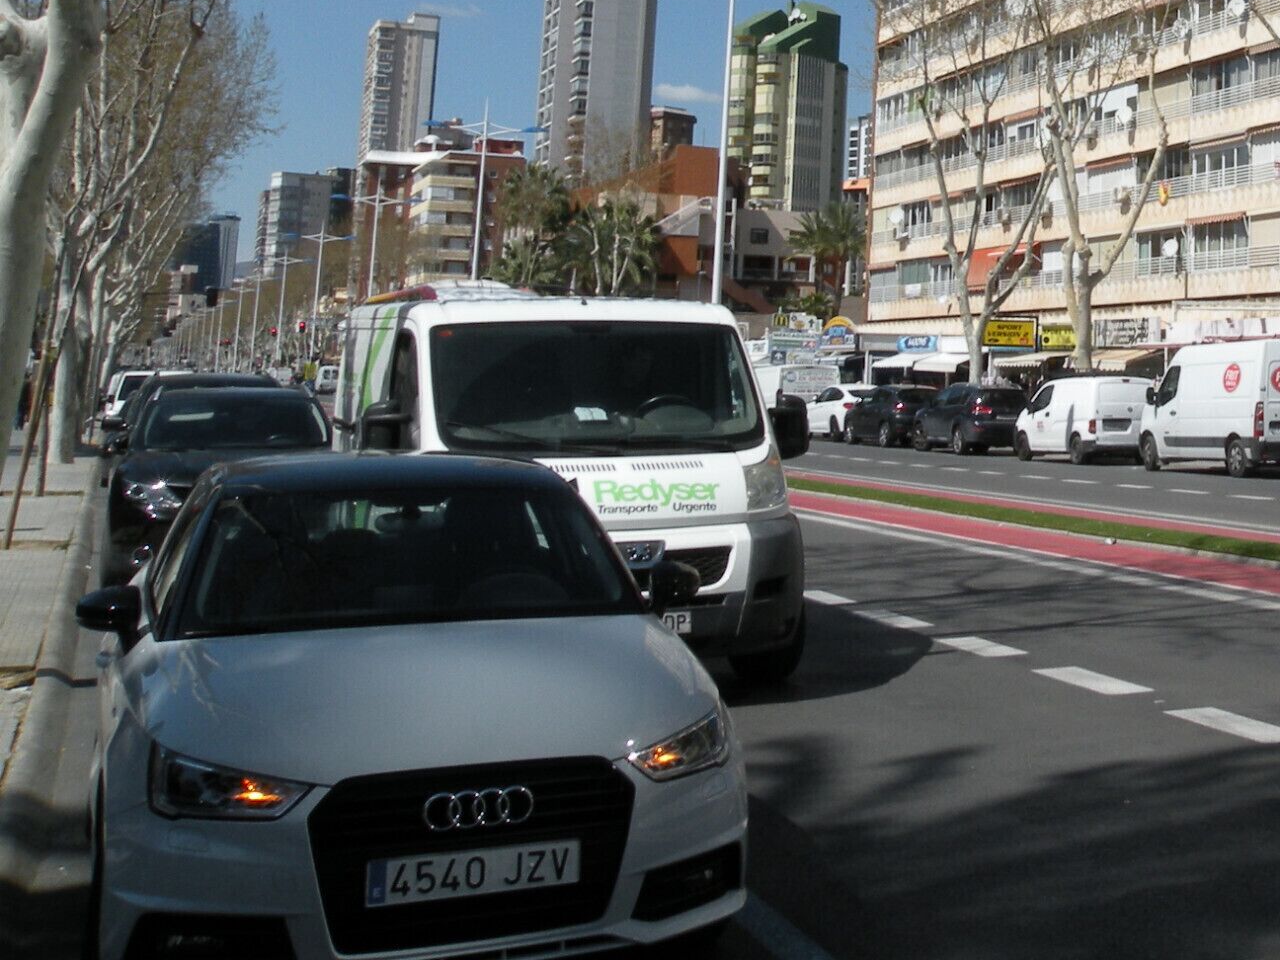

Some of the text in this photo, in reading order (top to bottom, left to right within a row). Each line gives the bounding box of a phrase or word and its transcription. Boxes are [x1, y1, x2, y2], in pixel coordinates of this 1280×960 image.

[987, 330, 1021, 338] VERSION
[593, 479, 720, 506] Redyser
[598, 501, 717, 515] Transporte Urgente
[664, 613, 687, 631] DP
[390, 856, 486, 896] 4540
[504, 847, 569, 886] JZV
